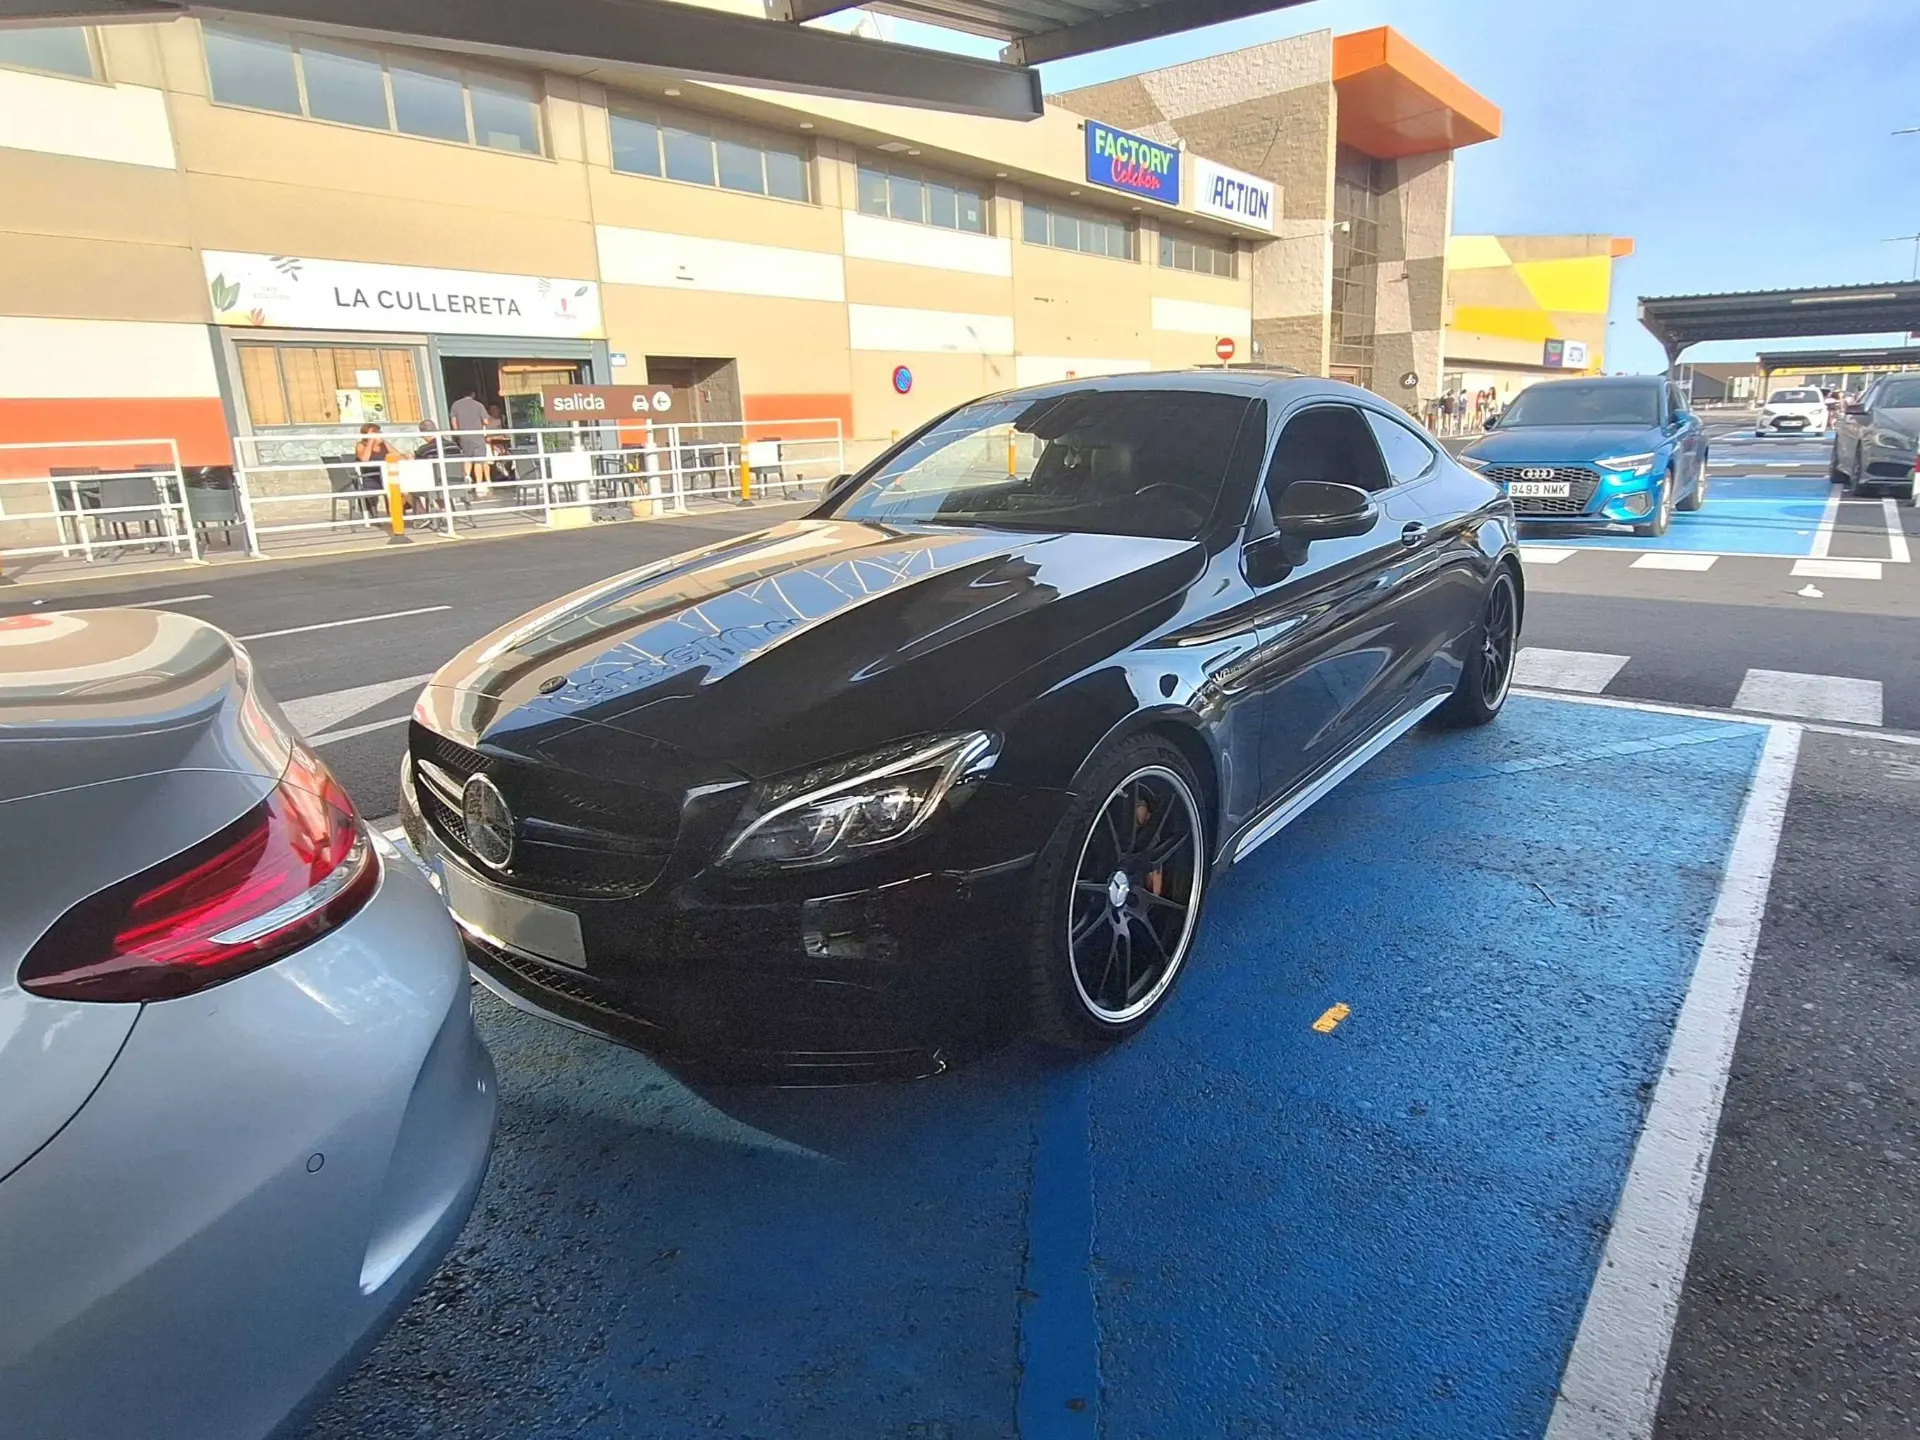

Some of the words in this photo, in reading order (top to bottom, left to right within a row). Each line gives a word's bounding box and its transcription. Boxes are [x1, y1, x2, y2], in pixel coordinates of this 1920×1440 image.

[1095, 128, 1170, 175] FACTORY
[1212, 175, 1269, 220] ACTION
[334, 287, 370, 308] LA
[377, 290, 522, 316] CULLERETA
[553, 393, 606, 411] salida
[1511, 484, 1540, 495] 9493
[1543, 484, 1567, 495] NMK
